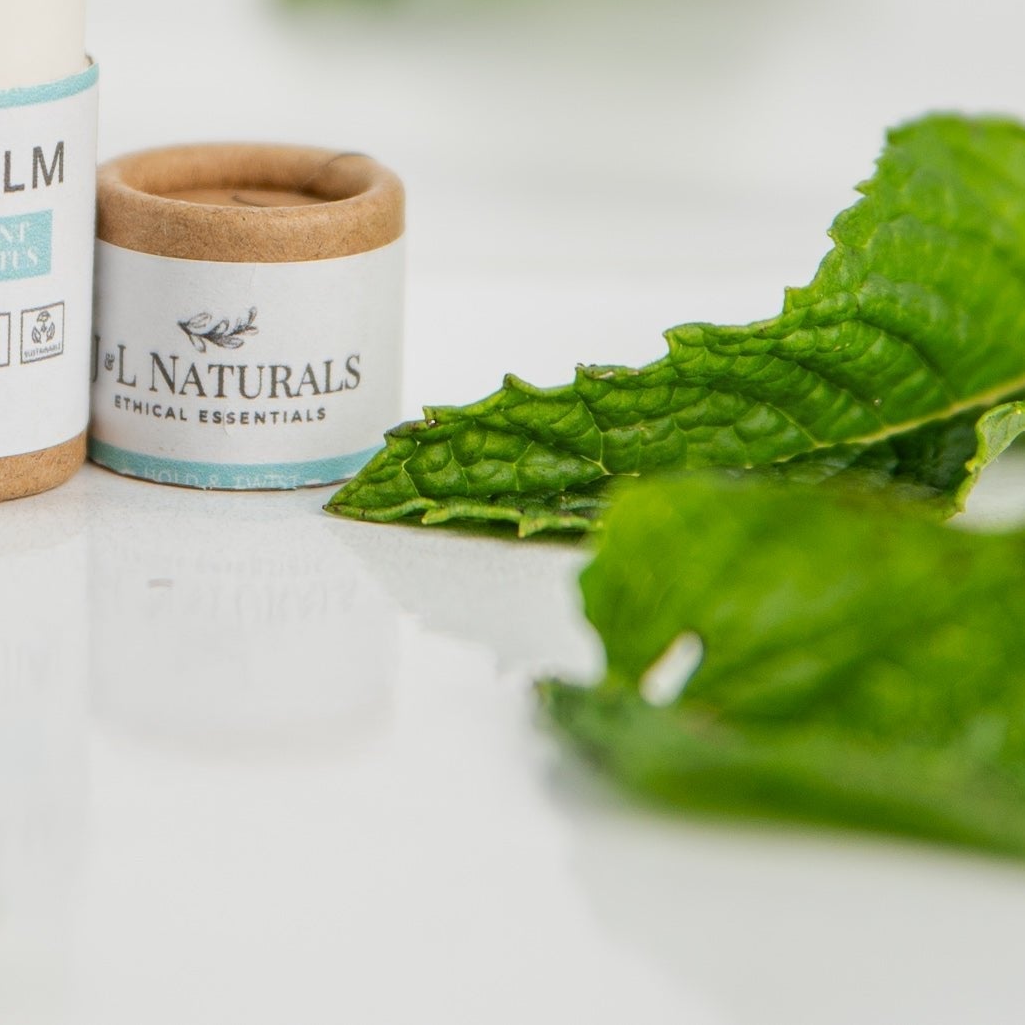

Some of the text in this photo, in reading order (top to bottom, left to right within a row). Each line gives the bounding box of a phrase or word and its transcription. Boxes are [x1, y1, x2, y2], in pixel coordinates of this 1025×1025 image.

[148, 353, 362, 400] NATURALS
[113, 394, 327, 425] ETHICAL ESSENTIALS
